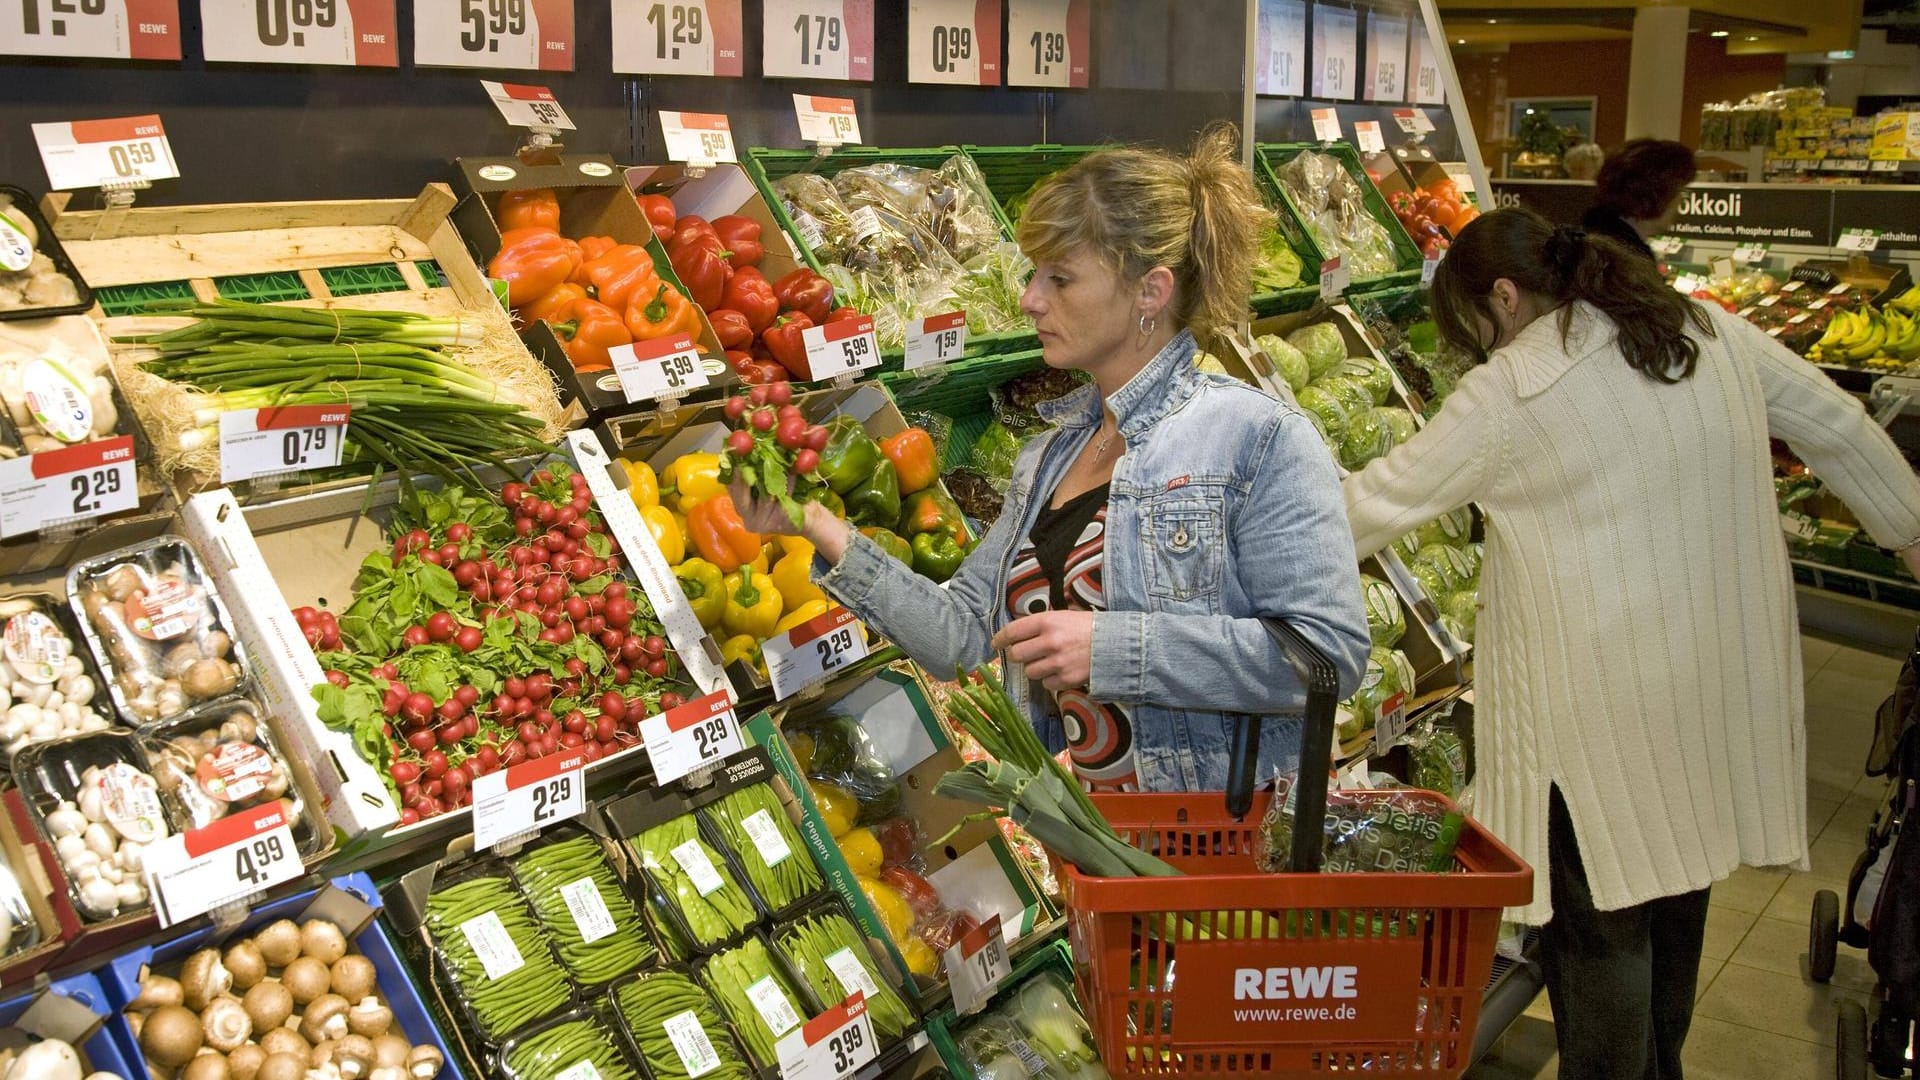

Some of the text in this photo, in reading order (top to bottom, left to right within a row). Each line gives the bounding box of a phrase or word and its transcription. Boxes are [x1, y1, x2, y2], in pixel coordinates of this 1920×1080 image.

[138, 23, 168, 35] REWE
[256, 0, 336, 47] 0.69
[461, 0, 526, 52] 5.99
[647, 3, 702, 60] 1.29
[362, 34, 386, 44] REWE
[546, 41, 565, 51] REWE
[793, 14, 840, 65] 1.79
[932, 25, 972, 73] 0.99
[719, 49, 736, 59] REWE
[1030, 31, 1064, 75] 1.39
[529, 103, 559, 124] 5.99
[135, 125, 160, 136] REWE
[828, 116, 852, 139] 1.59
[700, 133, 726, 158] 5.99
[109, 142, 156, 177] 0.59
[1677, 193, 1741, 216] okkoli
[1676, 223, 1703, 234] Kalium,
[1704, 224, 1735, 236] Calcium,
[1736, 225, 1771, 238] Phosphor
[1772, 227, 1789, 237] und
[1790, 228, 1813, 238] Eisen.
[1880, 230, 1918, 242] nthalten
[857, 321, 873, 332] REWE
[951, 318, 965, 327] REWE
[674, 339, 692, 352] REWE
[842, 337, 869, 368] 5.99
[934, 330, 957, 359] 1.59
[659, 355, 694, 388] 5.99
[320, 413, 346, 423] REWE
[1002, 414, 1027, 428] elis
[102, 447, 130, 461] REWE
[283, 427, 326, 466] 0.79
[71, 467, 120, 513] 2.29
[816, 628, 853, 672] 2.29
[710, 699, 729, 713] REWE
[693, 717, 728, 759] 2.29
[560, 756, 582, 771] REWE
[725, 757, 760, 775] GUATEMALA
[729, 763, 765, 785] PRODUCE OF
[532, 777, 571, 822] 2.29
[253, 811, 281, 830] REWE
[235, 835, 284, 884] 4.99
[806, 821, 831, 861] Peppers
[832, 870, 857, 909] Paprika
[978, 941, 1000, 983] 1.69
[1234, 965, 1358, 1000] REWE
[847, 1001, 867, 1017] REWE
[1234, 1003, 1356, 1022] www.rewe.de
[829, 1024, 863, 1075] 3.99
